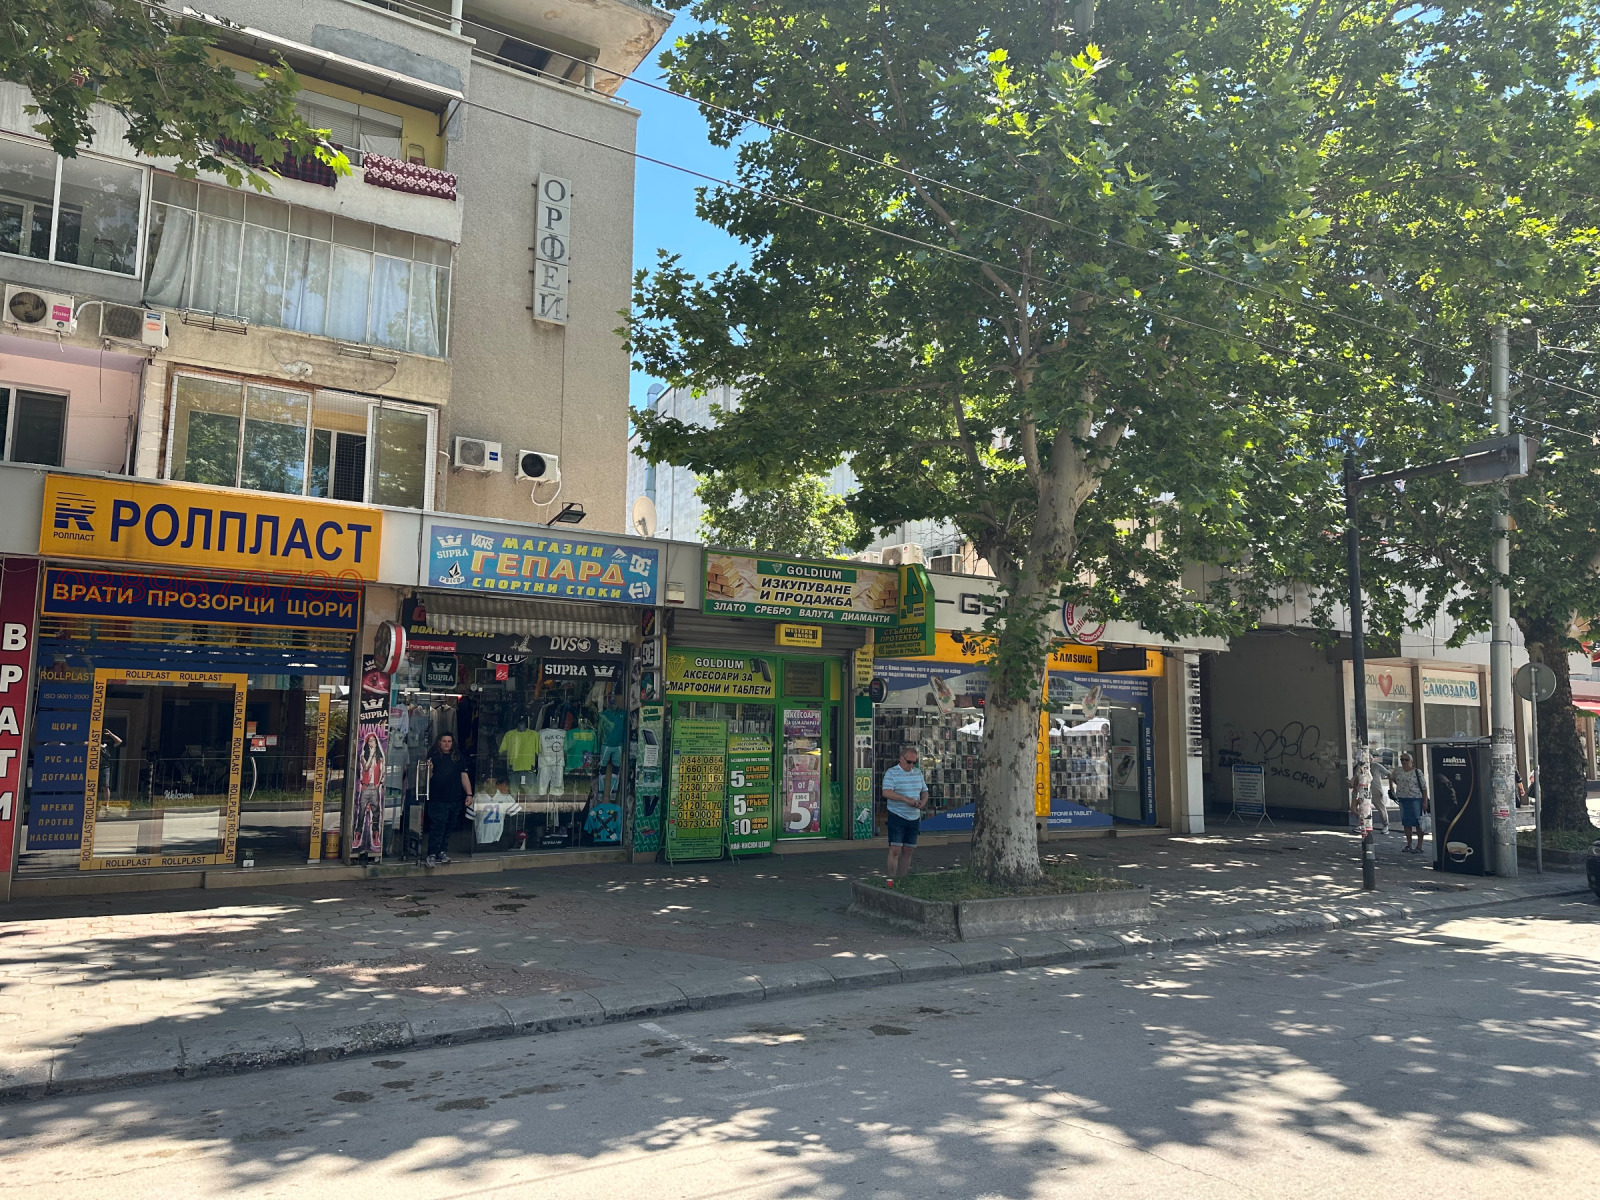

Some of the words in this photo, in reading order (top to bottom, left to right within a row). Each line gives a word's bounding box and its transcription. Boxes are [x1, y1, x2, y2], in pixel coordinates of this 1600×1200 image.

[538, 179, 566, 321] ОРФЕЙ
[53, 530, 95, 542] РОЛПЛАСТ
[110, 498, 372, 563] РОЛПЛАСТ
[471, 533, 494, 550] VANS
[502, 537, 604, 558] МАГАЗИН
[436, 548, 469, 559] SUPRA
[471, 550, 626, 586] ГЕПАРД
[787, 565, 842, 580] GOLDIUM
[56, 568, 364, 602] 0889678790
[472, 577, 558, 595] СПОРТНИ
[566, 585, 622, 599] СТОКИ
[761, 578, 852, 595] ИЗКУПУВАНЕ
[52, 583, 133, 604] ВРАТИ
[147, 590, 275, 615] ПРОЗОРЦИ
[287, 601, 353, 618] ЩОРИ
[760, 590, 771, 601] И
[774, 591, 853, 608] ПРОДАЖБА
[713, 602, 747, 612] ЗЛАТО
[754, 605, 792, 616] СРЕБРО
[799, 608, 834, 620] ВАЛУТА
[841, 612, 890, 624] ДИАМАНТИ
[880, 633, 922, 642] ПРОТЕКТОР
[884, 627, 918, 636] СТЪКЛЕН
[550, 637, 578, 651] DVS
[695, 657, 744, 669] GOLDIUM
[1053, 653, 1092, 664] SAMSUNG
[40, 671, 95, 681] ROLLPLAST
[125, 670, 171, 680] ROLLPLAST
[179, 672, 222, 681] ROLLPLAST
[428, 673, 454, 682] SUPRA
[544, 664, 587, 676] SUPRA
[683, 670, 739, 681] АКСЕСОАРИ
[742, 673, 753, 682] ЗА
[723, 684, 730, 693] И
[732, 684, 771, 696] ТАБЛЕТИ
[1422, 676, 1478, 699] САМОЗДРАВ
[92, 681, 104, 721] ROLLPLAST
[234, 691, 244, 729] ROLLPLAST
[360, 710, 389, 720] SUPRA
[317, 712, 326, 749] ROLLPLAST
[89, 729, 100, 770] ROLLPLAST
[231, 737, 242, 776] ROLLPLAST
[44, 755, 62, 763] PVC
[73, 755, 83, 763] AL
[41, 773, 84, 782] ДОГРАМА
[314, 756, 324, 794] ROLLPLAST
[730, 770, 745, 788] 5
[680, 783, 701, 791] 2230
[856, 776, 871, 792] 8D
[86, 779, 96, 819] ROLLPLAST
[164, 789, 194, 800] Welcome
[227, 784, 239, 822] ROLLPLAST
[678, 801, 700, 809] 2120
[702, 801, 722, 809] 2170
[733, 795, 747, 815] 5
[789, 792, 812, 830] 5
[38, 818, 74, 826] ПРОТИВ
[312, 801, 321, 838] ROLLPLAST
[484, 804, 501, 824] 21
[678, 820, 699, 829] 0373
[701, 820, 721, 828] 0410
[30, 833, 79, 841] НАСЕКОМИ
[82, 820, 93, 861] ROLLPLAST
[225, 821, 236, 862] ROLLPLAST
[105, 858, 152, 868] ROLLPLAST
[161, 856, 206, 866] ROLLPLAST
